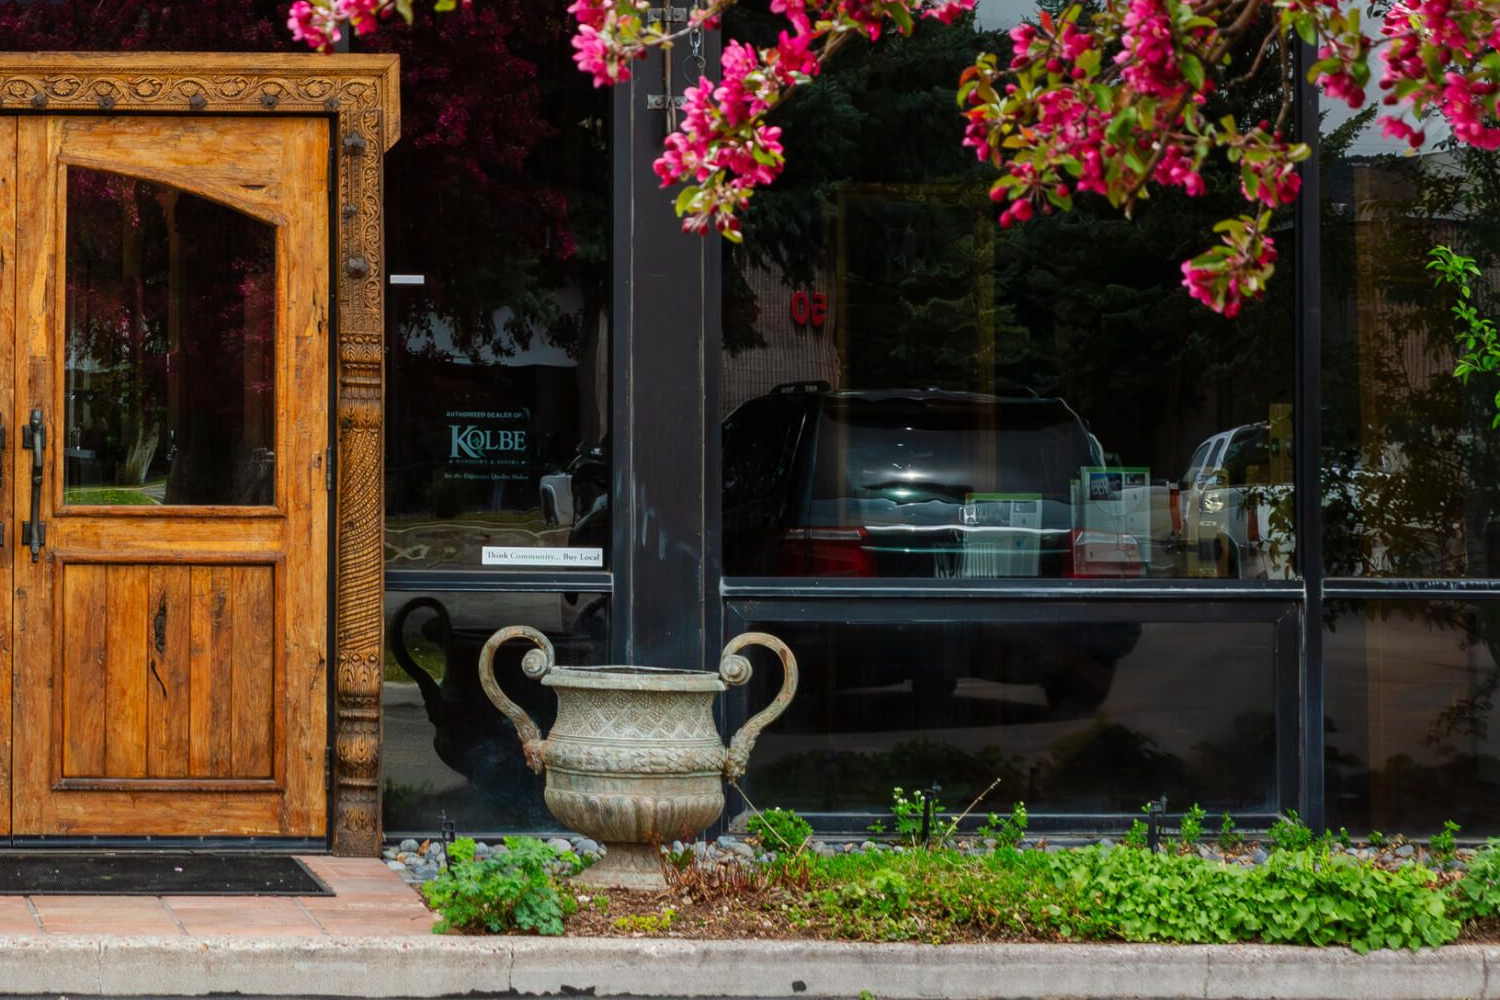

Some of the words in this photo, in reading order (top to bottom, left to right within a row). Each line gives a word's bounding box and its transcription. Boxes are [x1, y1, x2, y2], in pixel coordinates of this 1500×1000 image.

[445, 410, 486, 418] AUTHORIZED
[487, 551, 508, 559] Think
[563, 553, 577, 562] Buy
[580, 553, 600, 561] Local
